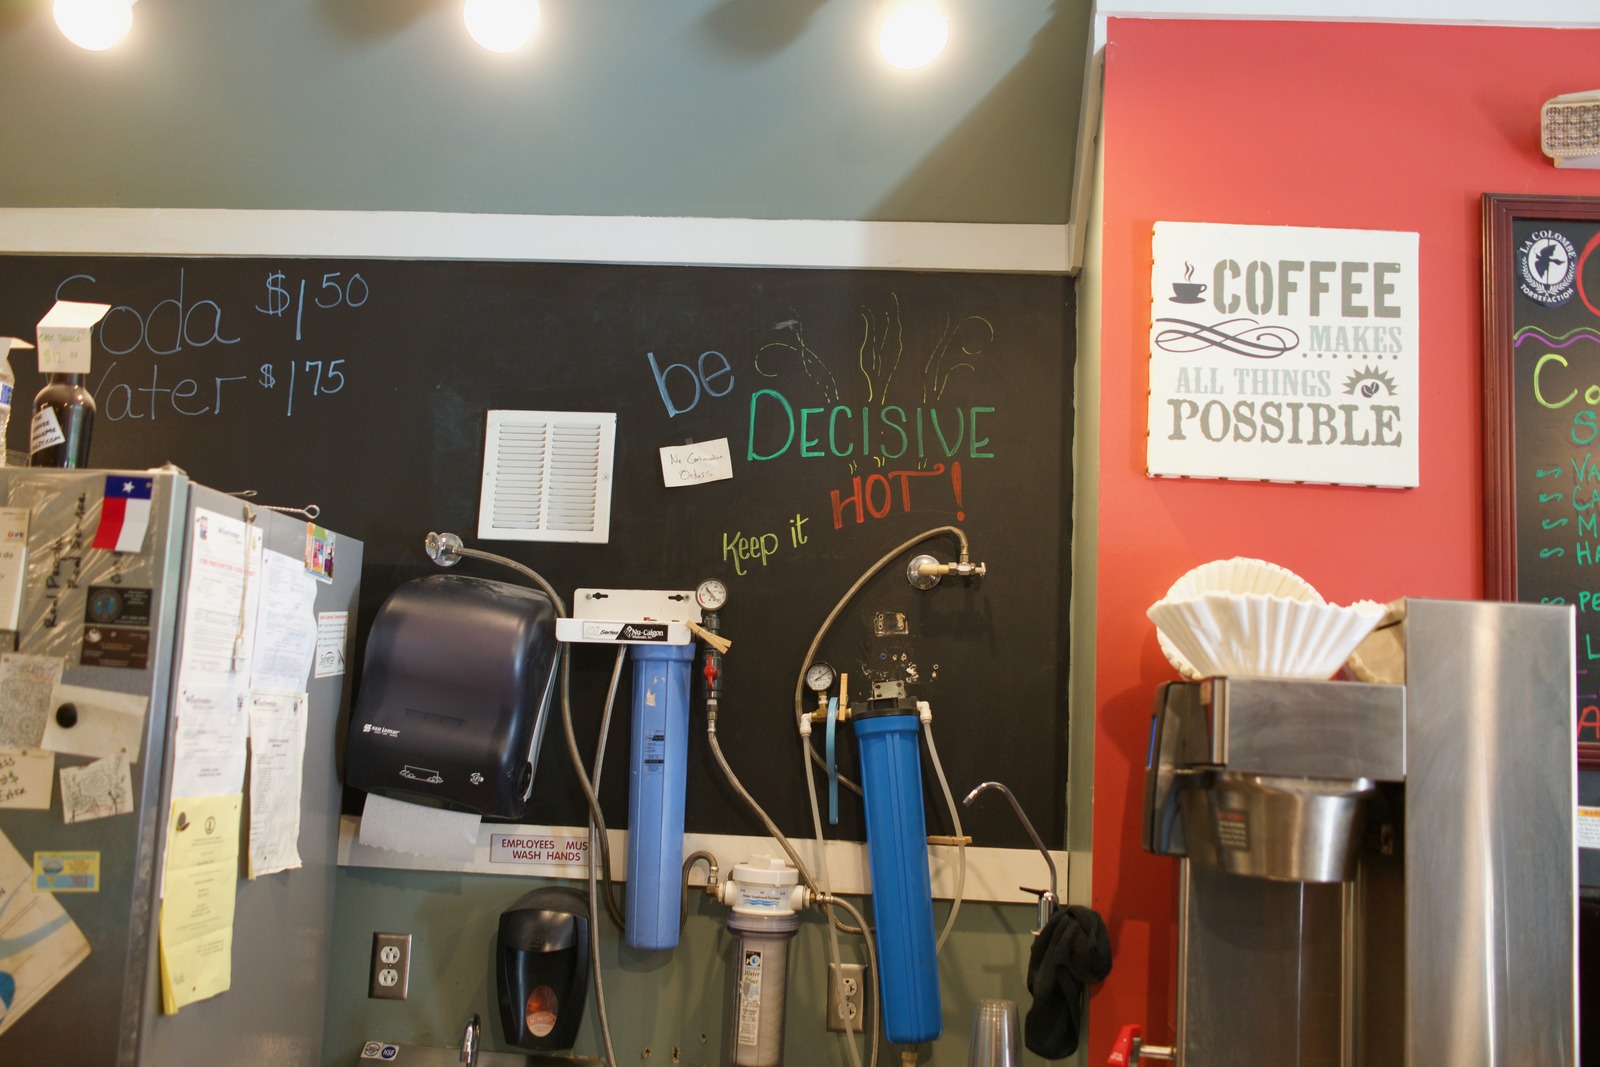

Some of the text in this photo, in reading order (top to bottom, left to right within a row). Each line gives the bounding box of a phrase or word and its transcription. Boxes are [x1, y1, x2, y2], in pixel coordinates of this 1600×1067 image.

[1519, 229, 1577, 259] LA COLOMBE
[1213, 258, 1401, 318] COFFEE
[1519, 283, 1575, 303] TORREFACTION
[1308, 324, 1403, 353] MAKES
[647, 350, 735, 418] be
[1175, 367, 1332, 397] ALL THINGS
[747, 388, 995, 461] DECISIVE
[1167, 398, 1402, 447] POSSIBLE
[723, 530, 779, 577] Keep
[790, 513, 810, 549] it
[631, 628, 664, 638] Nu-Calgon
[501, 838, 589, 850] EMPLOYEES MUS
[512, 849, 581, 861] WASH HANDS
